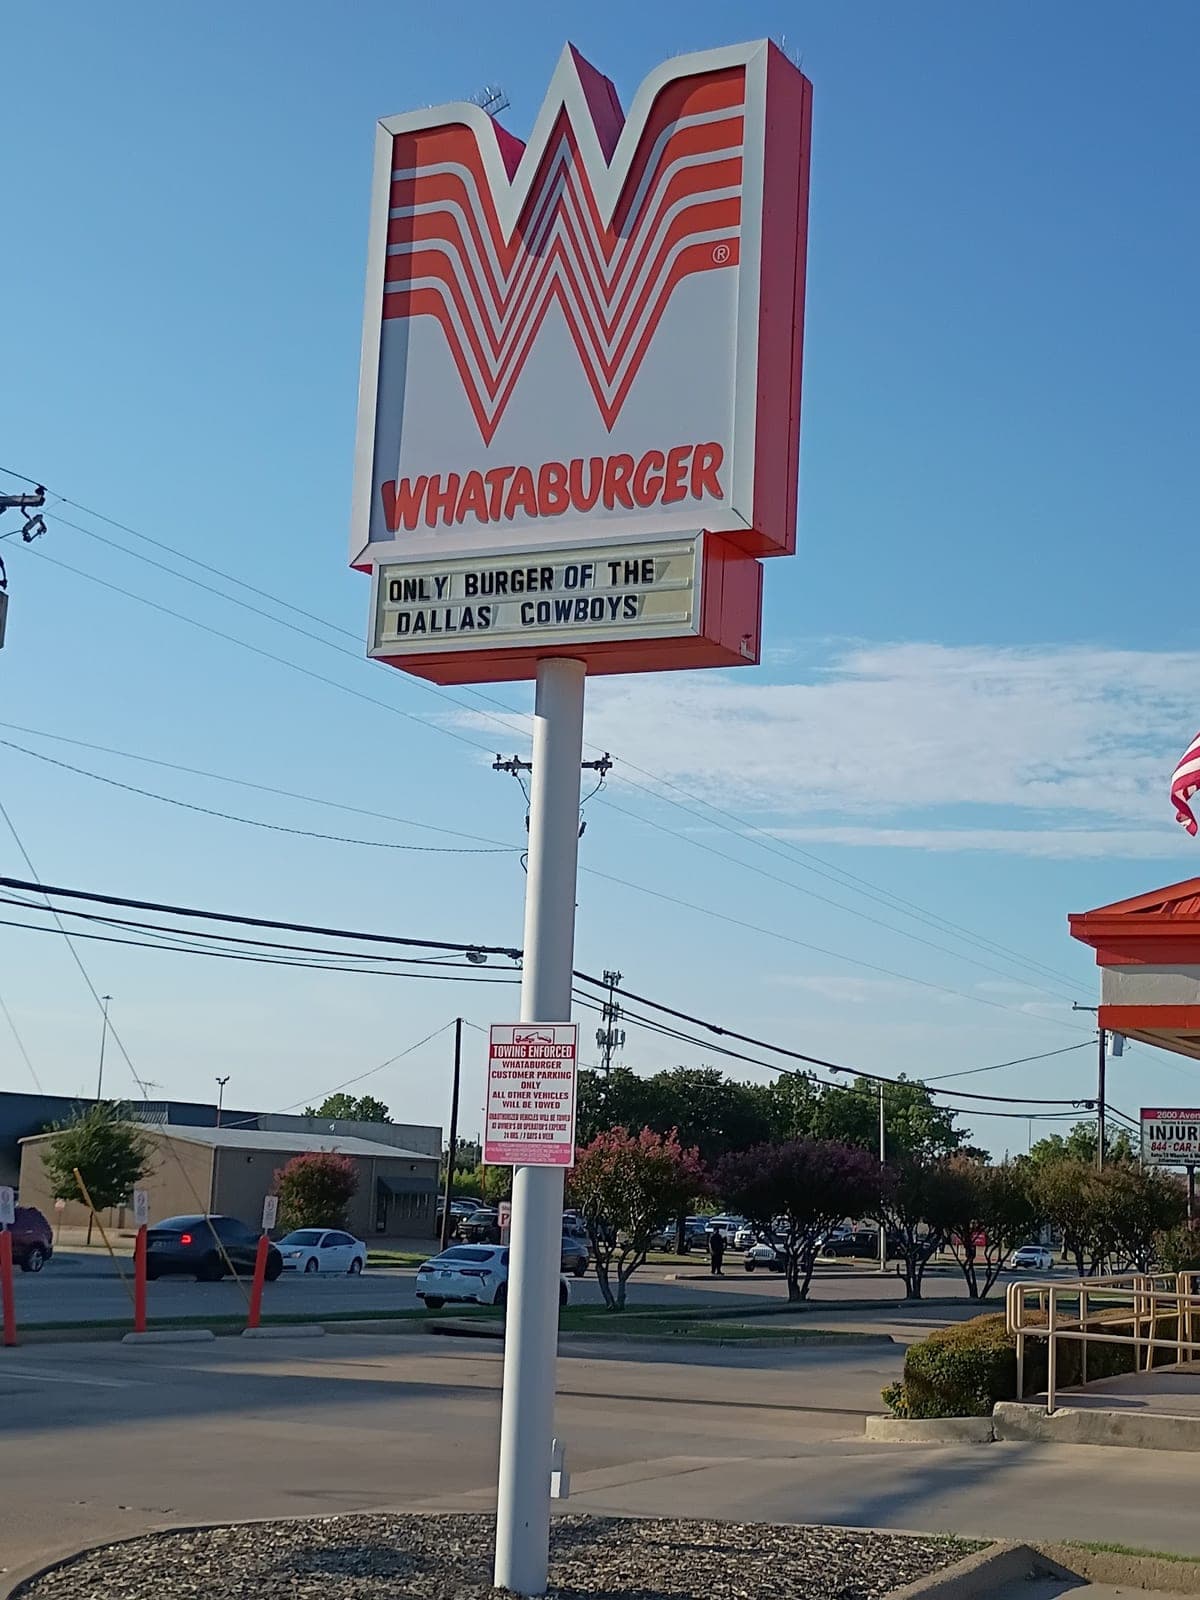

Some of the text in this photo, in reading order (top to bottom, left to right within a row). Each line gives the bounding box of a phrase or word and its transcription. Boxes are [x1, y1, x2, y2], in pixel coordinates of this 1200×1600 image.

[381, 441, 724, 532] WHATABURGER
[389, 559, 655, 602] ONLY BURGER OF THE
[397, 595, 639, 636] DALLAS COWBOYS
[493, 1045, 572, 1058] TOWING ENFORCED
[502, 1061, 562, 1069] WHATABURGER
[491, 1071, 571, 1079] CUSTOMER PARKING
[521, 1081, 541, 1089] ONLY
[492, 1091, 569, 1100] ALL OTHER VEHICLES
[502, 1100, 561, 1109] WILL BE TOWED
[1179, 1111, 1200, 1119] Aven
[1150, 1125, 1200, 1140] INJUR
